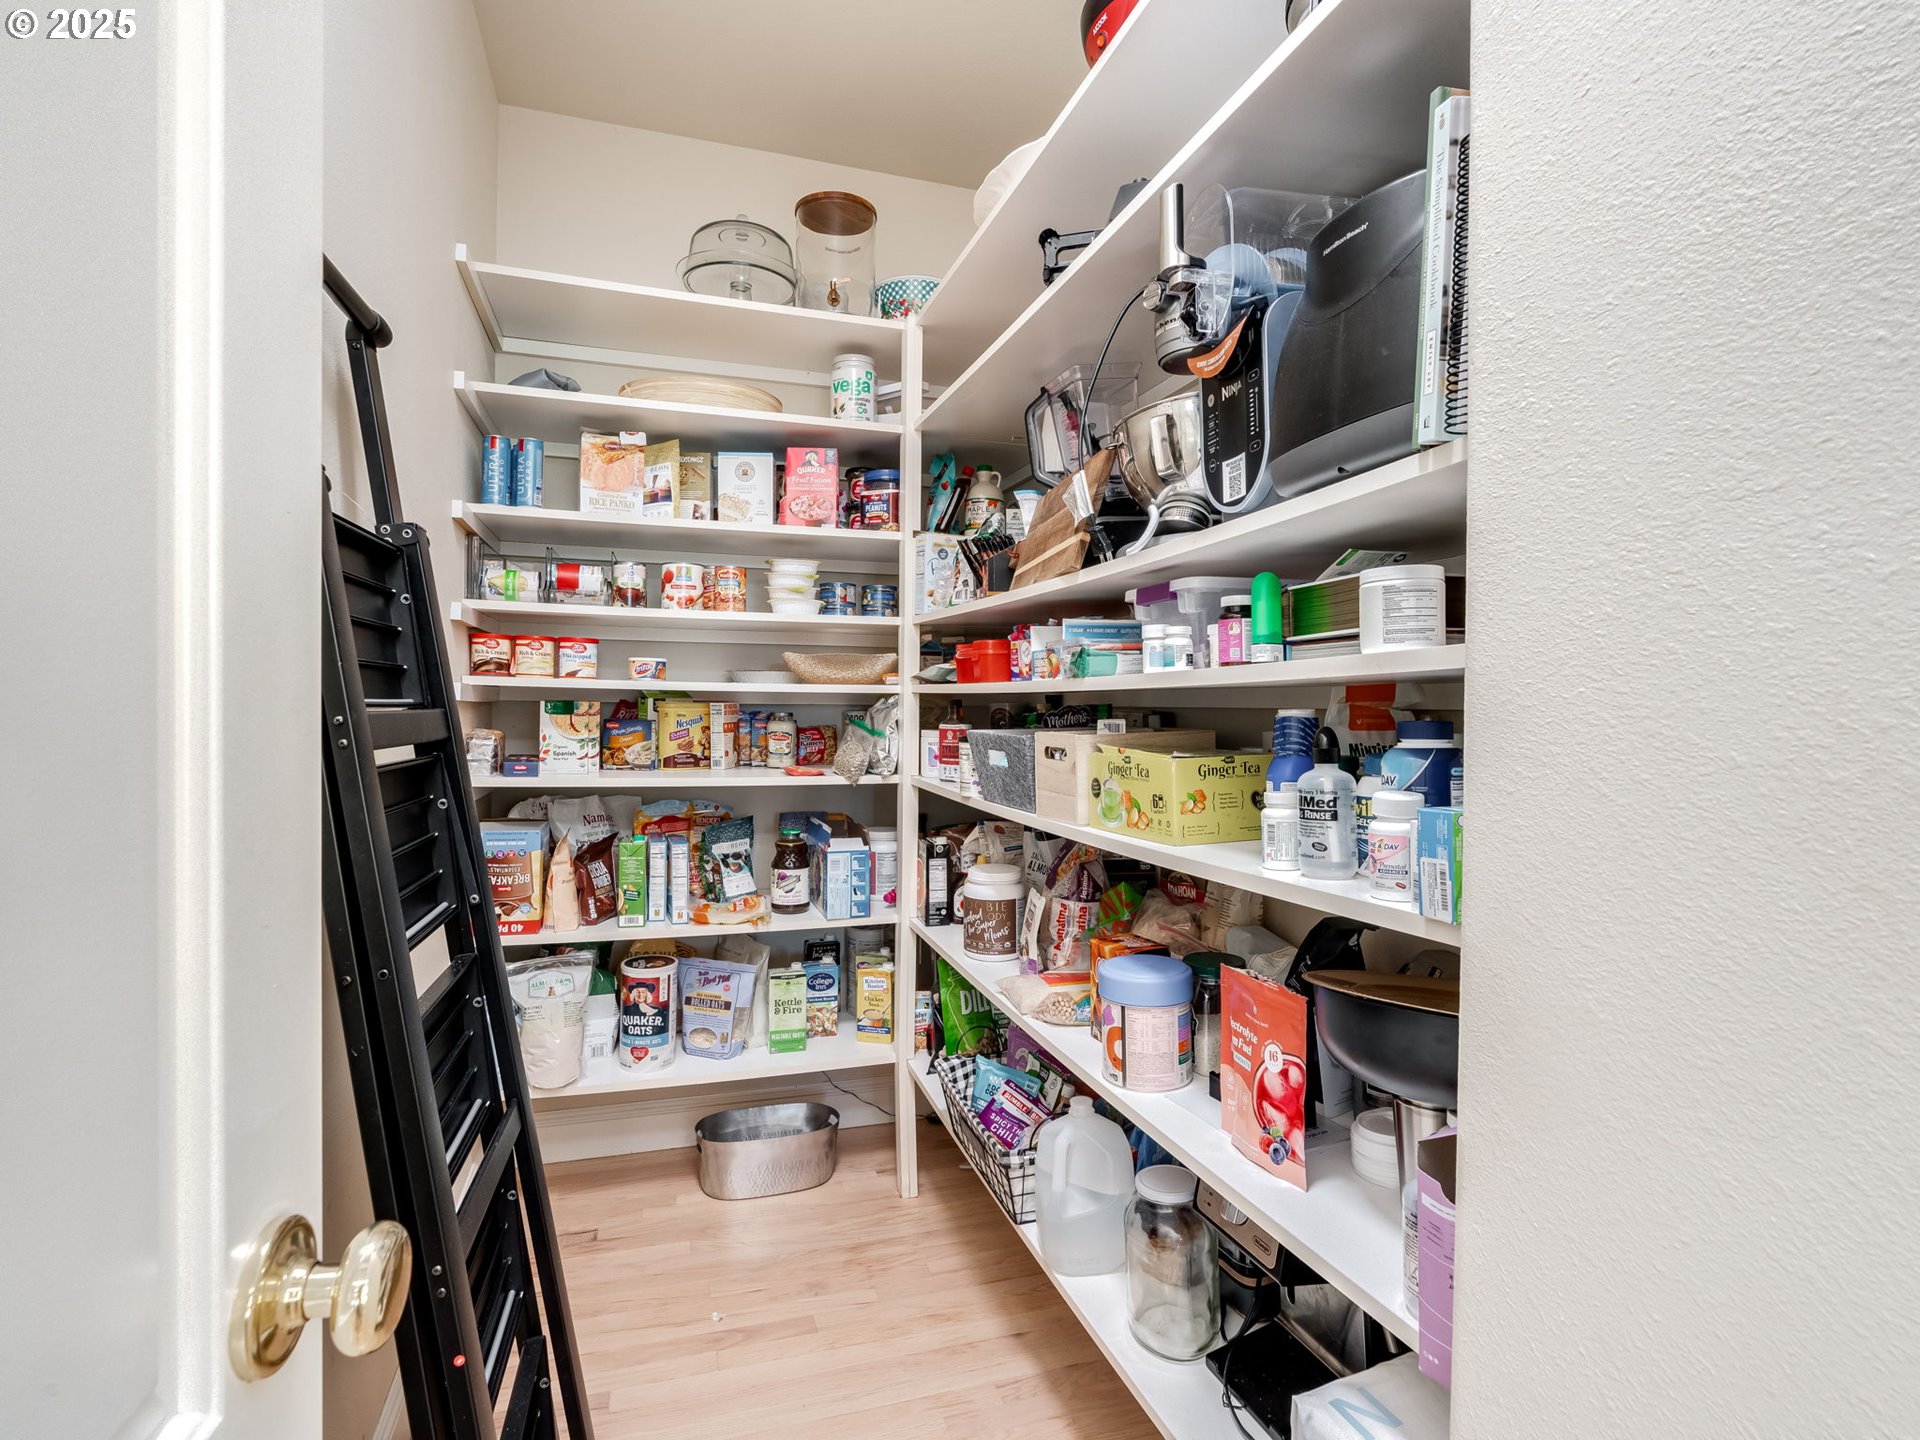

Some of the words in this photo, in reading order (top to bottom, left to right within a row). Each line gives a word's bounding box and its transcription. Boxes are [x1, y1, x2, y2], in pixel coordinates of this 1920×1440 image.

[1431, 178, 1444, 242] Simplified
[1323, 236, 1347, 256] Hamilton
[1429, 245, 1441, 310] Cookbook
[832, 378, 871, 397] vega
[1221, 380, 1242, 402] NINJA
[487, 454, 499, 494] ULTRA
[516, 455, 525, 495] ULTRA
[797, 467, 826, 475] QUAKER
[588, 497, 608, 507] RICE
[608, 499, 635, 509] PANKO
[865, 503, 888, 513] PEANUTS
[676, 714, 704, 729] Nesquik
[1046, 713, 1087, 728] Mother's
[553, 750, 577, 758] Spanish
[1107, 762, 1132, 780] Ginger
[1134, 764, 1149, 778] Tea
[1197, 763, 1237, 781] Ginger
[1239, 761, 1260, 775] Tea
[1304, 809, 1332, 820] RINSE
[587, 861, 608, 878] COCOA
[1379, 862, 1407, 870] Prenatal
[1080, 869, 1089, 899] Jasmine
[1167, 882, 1196, 899] IDAHOAN
[509, 923, 524, 934] 40
[983, 926, 1010, 944] Moms
[808, 977, 834, 987] College
[815, 983, 827, 991] Inn
[865, 977, 886, 985] Kitchen
[773, 997, 803, 1008] Kettle
[773, 1006, 782, 1016] &
[783, 1006, 803, 1015] Fire
[628, 1025, 653, 1036] OATS
[771, 1032, 792, 1040] VEGETABLE
[1238, 1037, 1253, 1057] Fuel
[1268, 1049, 1279, 1063] 16
[1002, 1091, 1029, 1114] BUMBLE
[990, 1111, 1013, 1129] SPICY
